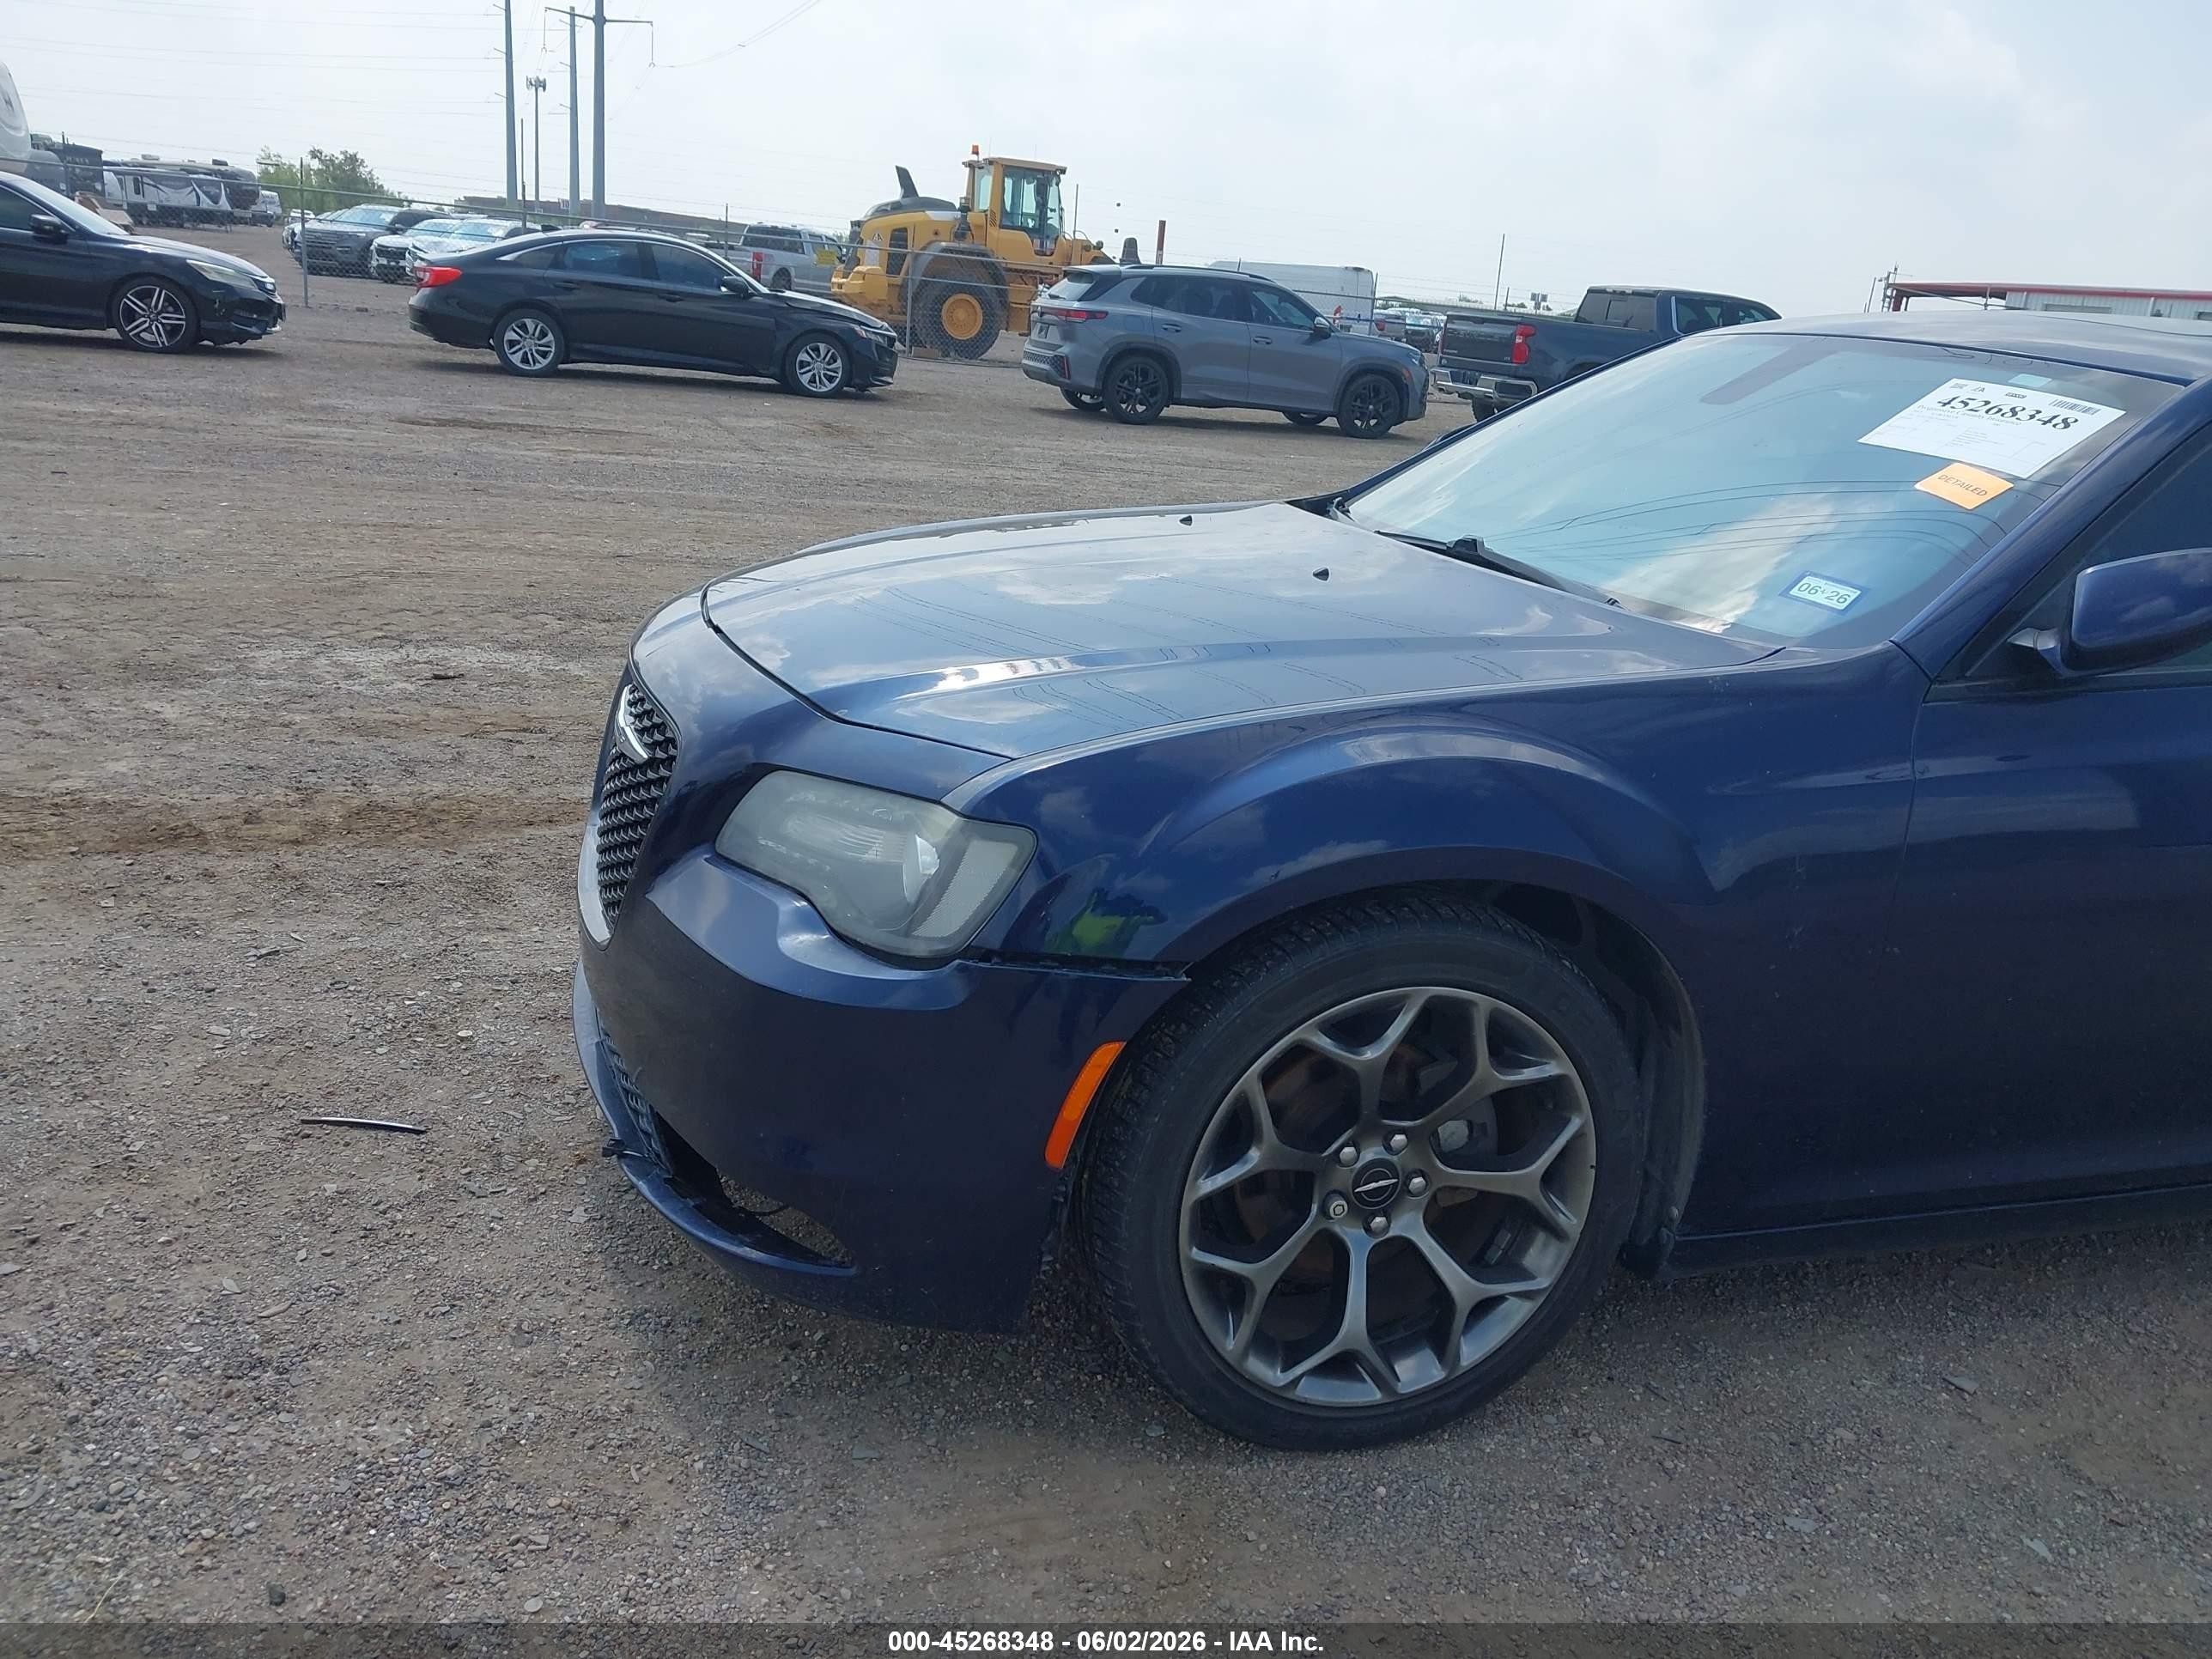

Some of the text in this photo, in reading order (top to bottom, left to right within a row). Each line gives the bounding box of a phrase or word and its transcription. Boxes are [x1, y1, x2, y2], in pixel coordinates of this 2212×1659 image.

[1937, 395, 2079, 430] 45268348
[1937, 474, 1989, 496] DETAILED
[1797, 582, 1851, 604] 06 26
